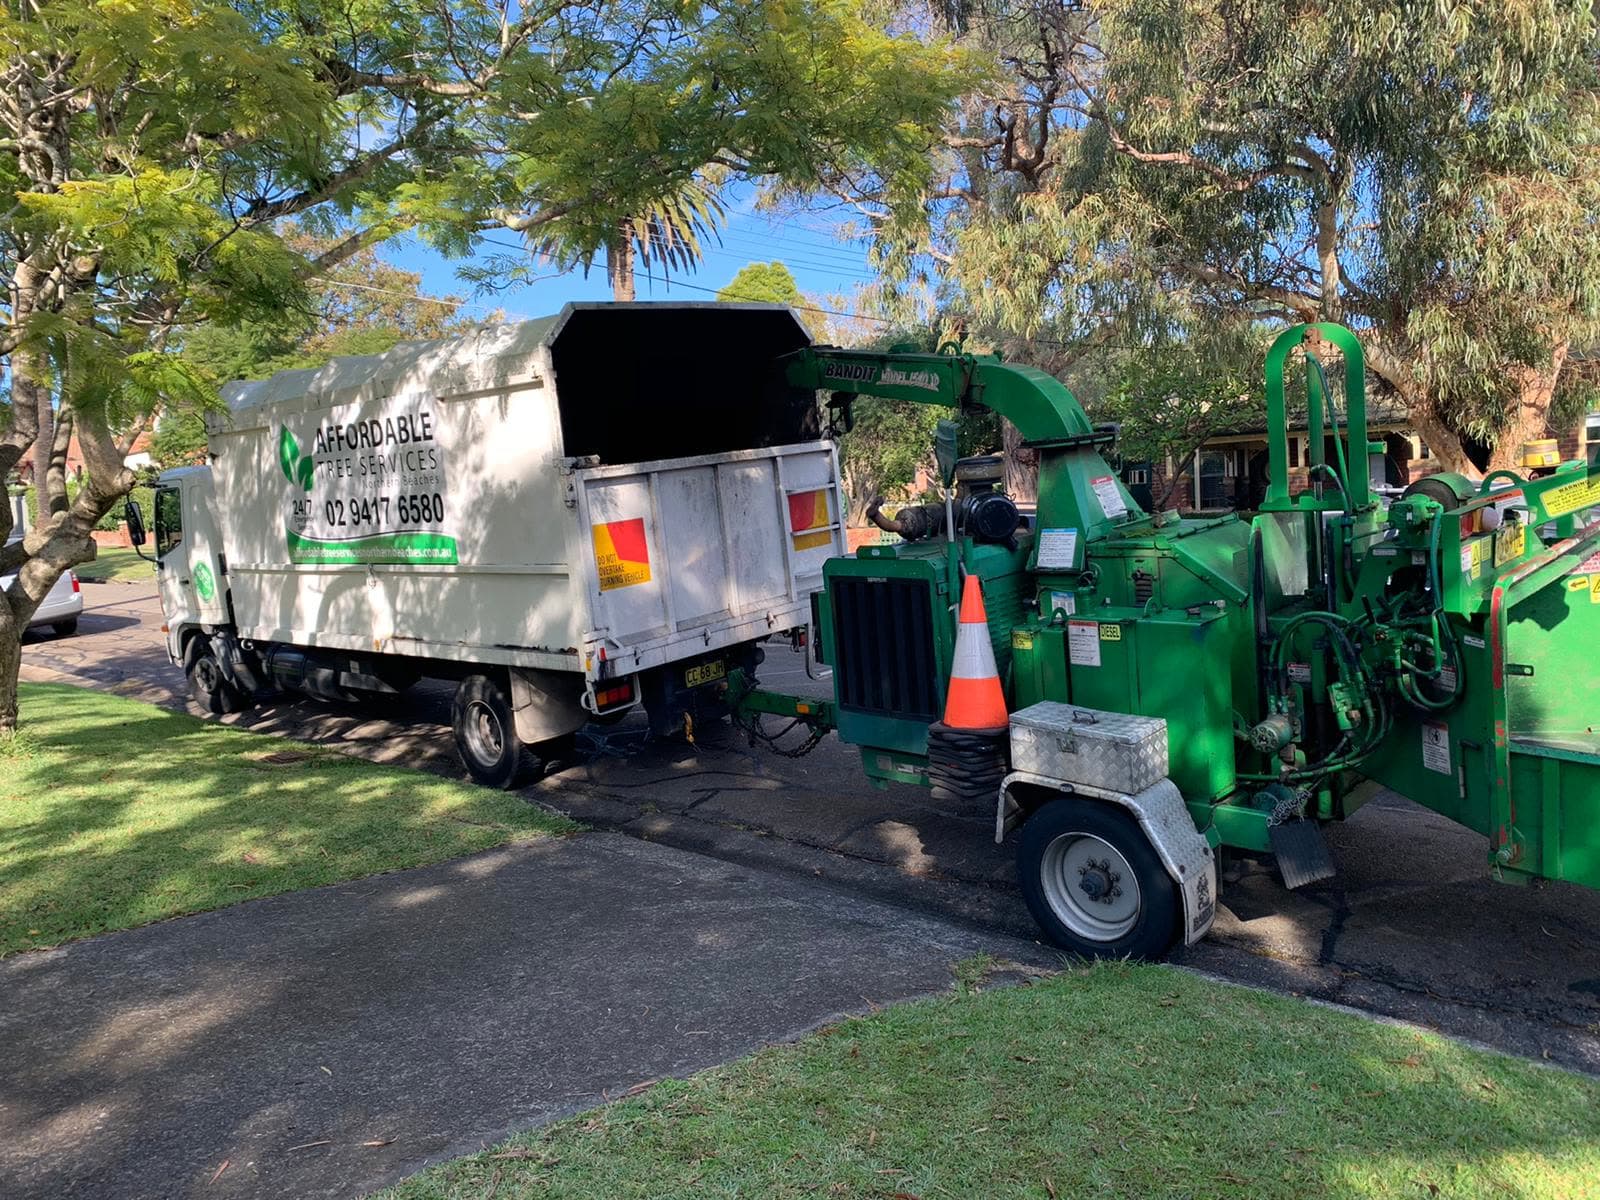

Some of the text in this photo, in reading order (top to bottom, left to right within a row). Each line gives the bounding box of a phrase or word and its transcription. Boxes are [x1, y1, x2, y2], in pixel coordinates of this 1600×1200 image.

[825, 362, 876, 382] BANDIT
[317, 413, 433, 454] AFFORDABLE
[318, 449, 437, 479] TREE SERVICES
[362, 475, 439, 489] Northern Beaches
[293, 493, 444, 526] 24/7 02 9417 6580
[687, 669, 698, 683] CC
[701, 665, 711, 680] 68
